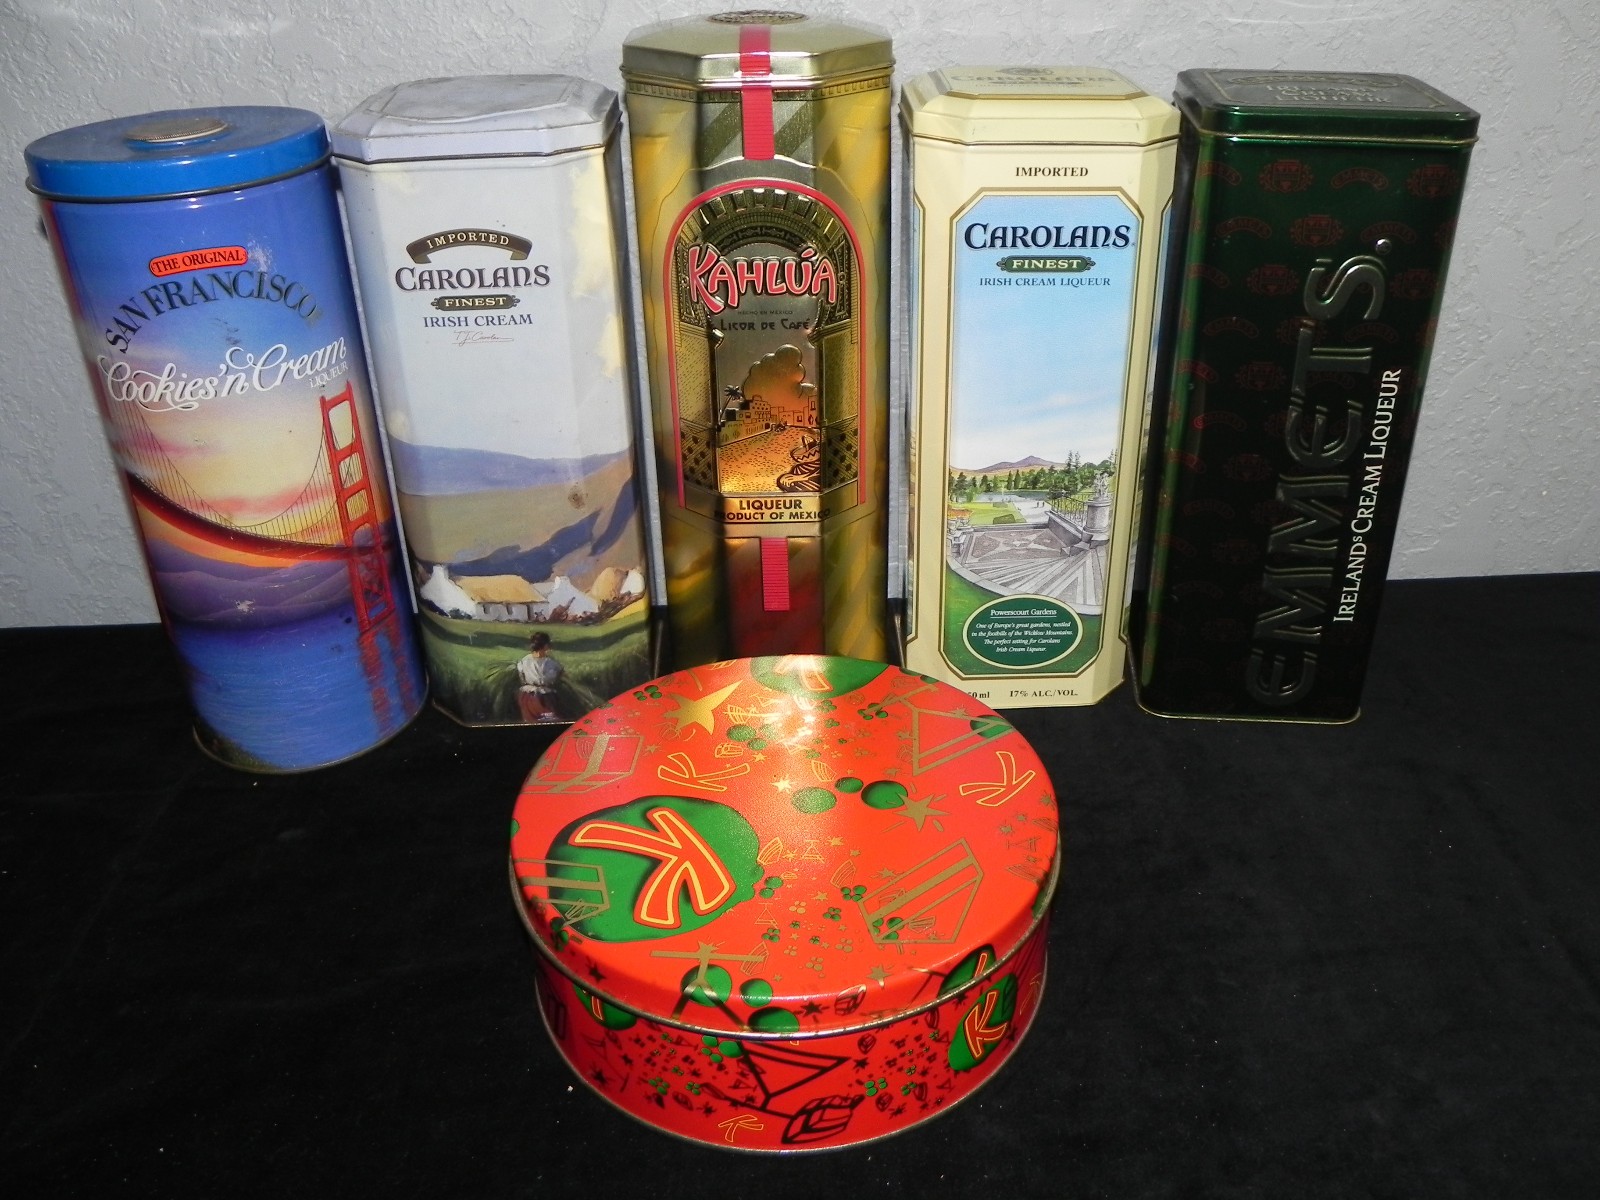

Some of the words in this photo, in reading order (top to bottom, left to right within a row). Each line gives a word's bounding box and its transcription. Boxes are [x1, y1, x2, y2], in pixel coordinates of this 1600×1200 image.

[1015, 166, 1089, 177] IMPORTED
[427, 232, 510, 249] IMPORTED
[964, 222, 1131, 249] CAROLANS
[152, 257, 179, 274] THE
[182, 249, 243, 267] ORIGINAL
[1012, 259, 1081, 269] FINEST
[395, 264, 551, 292] CAROLANS
[688, 246, 836, 313] KAHLÚA
[979, 277, 1012, 286] IRISH
[1015, 277, 1056, 286] CREAM
[1060, 277, 1111, 288] LIQUEUR
[445, 297, 507, 308] FINEST
[104, 297, 151, 354] SAN
[141, 269, 319, 319] FRANCISCO
[423, 316, 470, 328] IRISH
[474, 314, 533, 326] CREAM
[720, 318, 756, 331] LICOR
[225, 336, 347, 392] Cream
[309, 361, 348, 389] LIQUEUR
[1364, 369, 1401, 459] LIQUEUR
[739, 499, 803, 510] LIQUEUR
[1351, 464, 1383, 533] CREAM
[769, 511, 785, 520] OF
[789, 508, 831, 520] MEXICO
[1031, 608, 1057, 616] Gardens
[987, 622, 994, 630] of
[994, 622, 1016, 630] Europe's
[986, 630, 1008, 638] foothills
[993, 638, 1011, 646] perfect
[979, 691, 990, 699] ml
[1009, 690, 1028, 698] 17%
